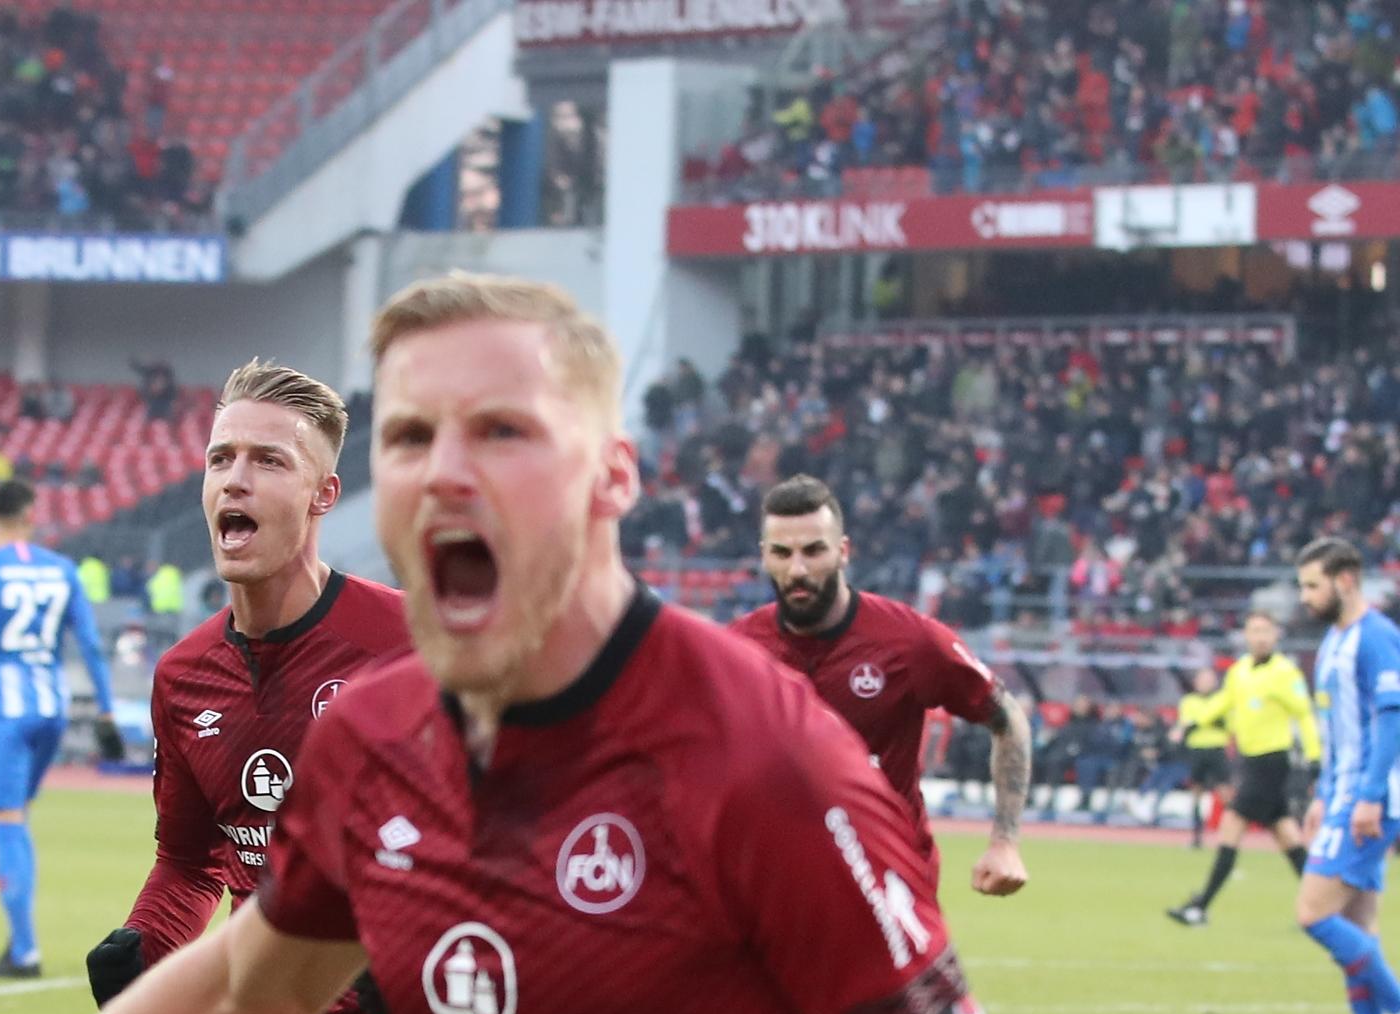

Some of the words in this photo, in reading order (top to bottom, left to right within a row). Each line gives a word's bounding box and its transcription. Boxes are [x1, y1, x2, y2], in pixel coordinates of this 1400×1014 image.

[8, 236, 222, 283] BRUNNEN
[0, 581, 70, 652] 27
[564, 852, 635, 892] FCN
